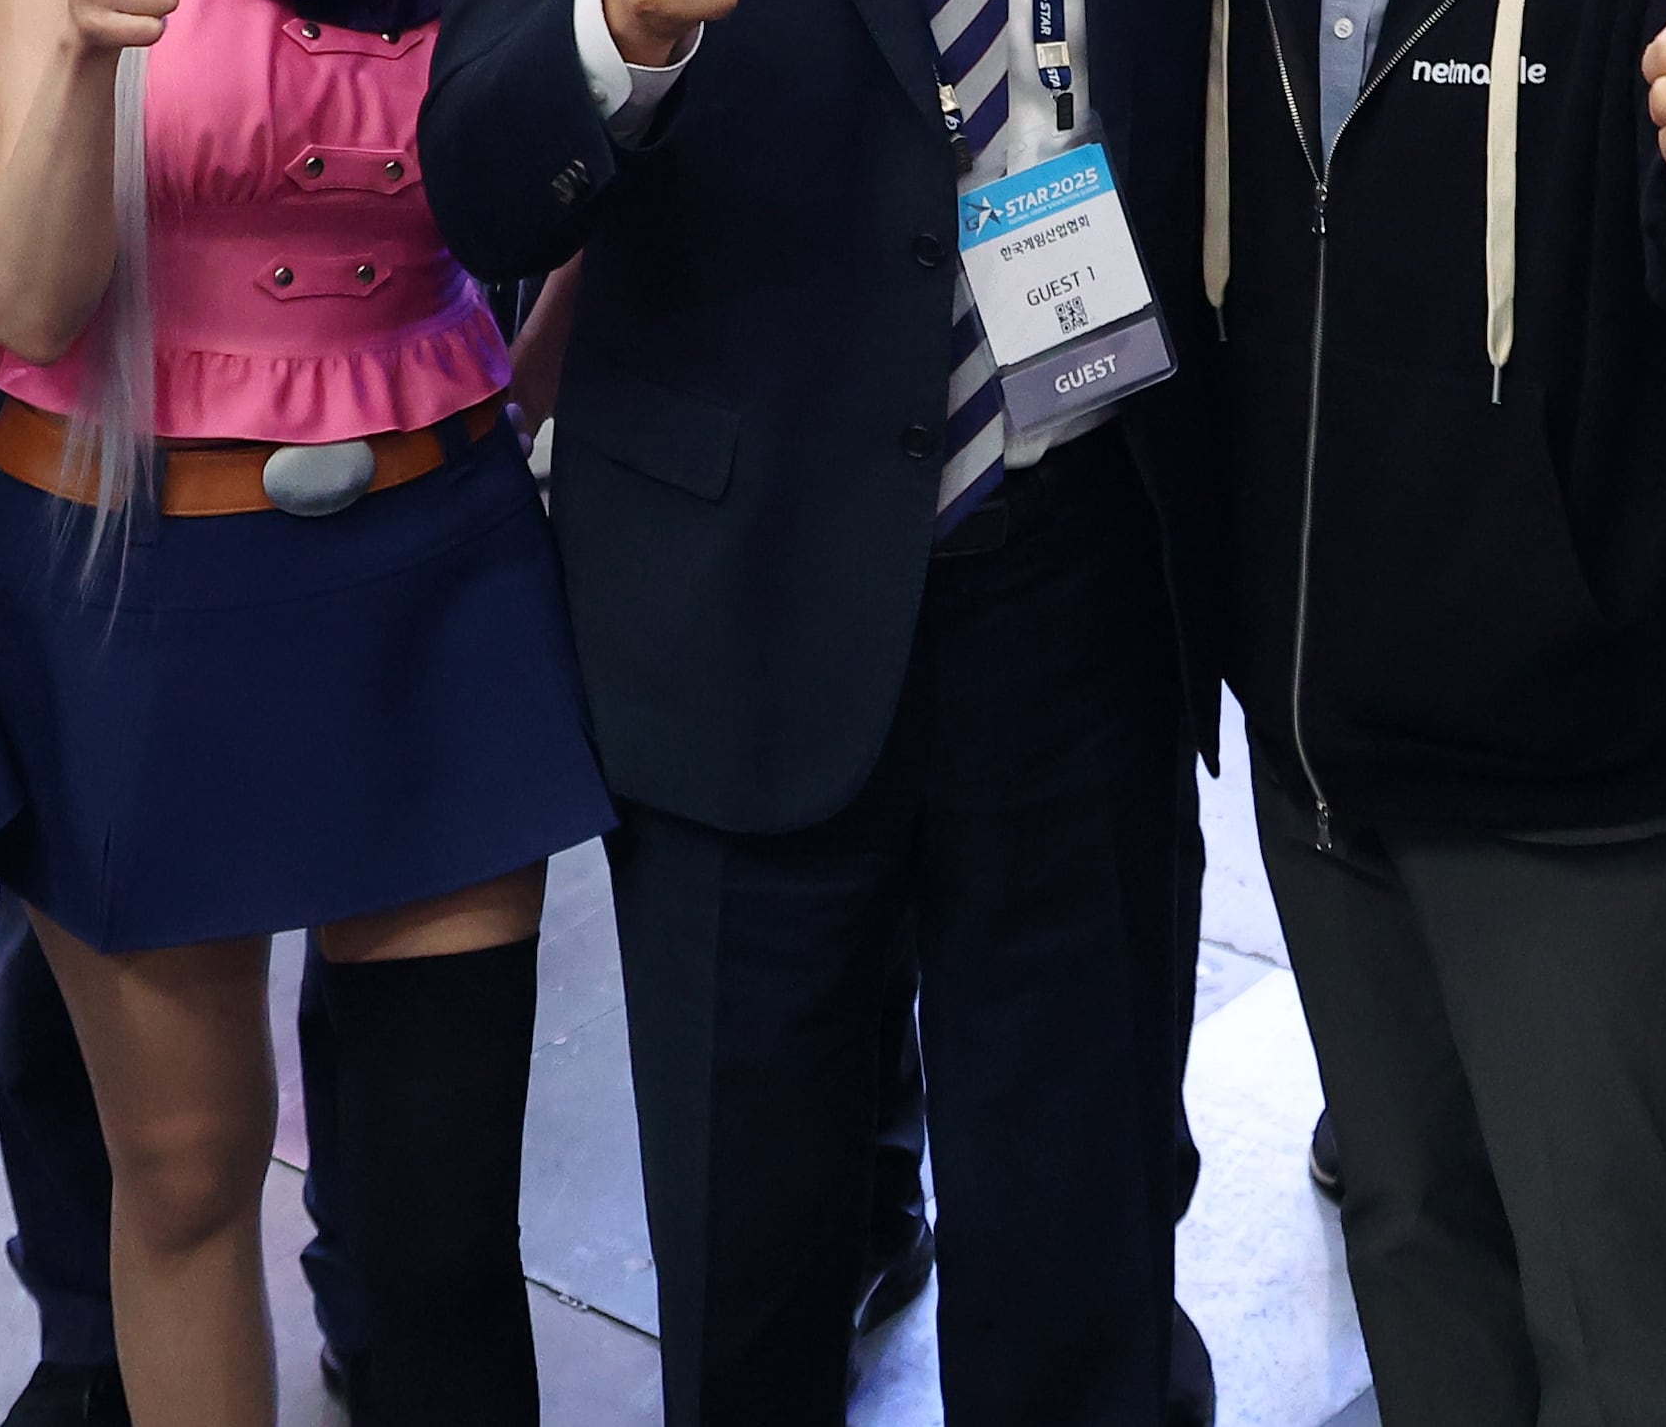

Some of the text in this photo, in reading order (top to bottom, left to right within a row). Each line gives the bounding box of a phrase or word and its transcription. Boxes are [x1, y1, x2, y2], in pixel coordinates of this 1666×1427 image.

[1412, 55, 1547, 85] netmale
[999, 214, 1091, 262] 한국게임산업협회
[1026, 265, 1097, 307] GUEST 1
[1054, 353, 1118, 395] GUEST
